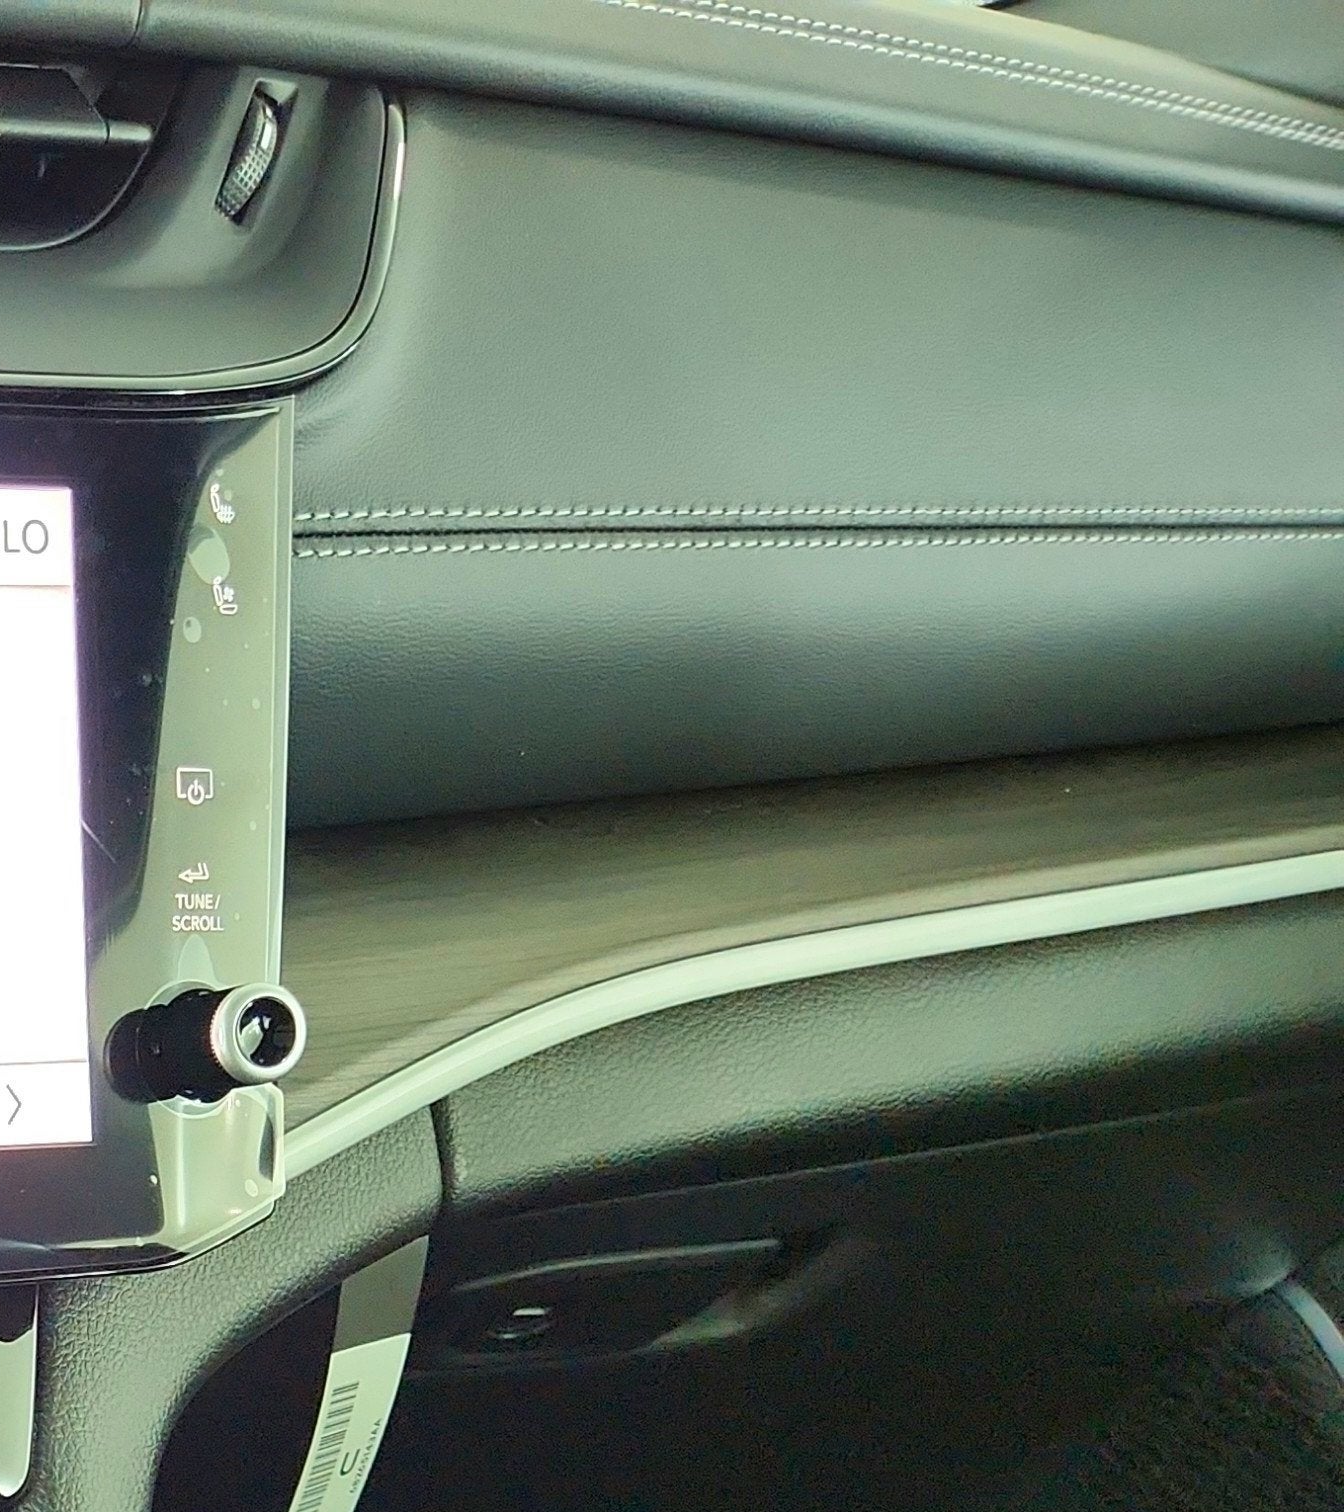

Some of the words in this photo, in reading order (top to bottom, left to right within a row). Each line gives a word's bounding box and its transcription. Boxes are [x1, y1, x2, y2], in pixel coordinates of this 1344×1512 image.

[2, 520, 49, 554] LO
[174, 893, 221, 910] TUNE/
[172, 915, 225, 932] SCROLL
